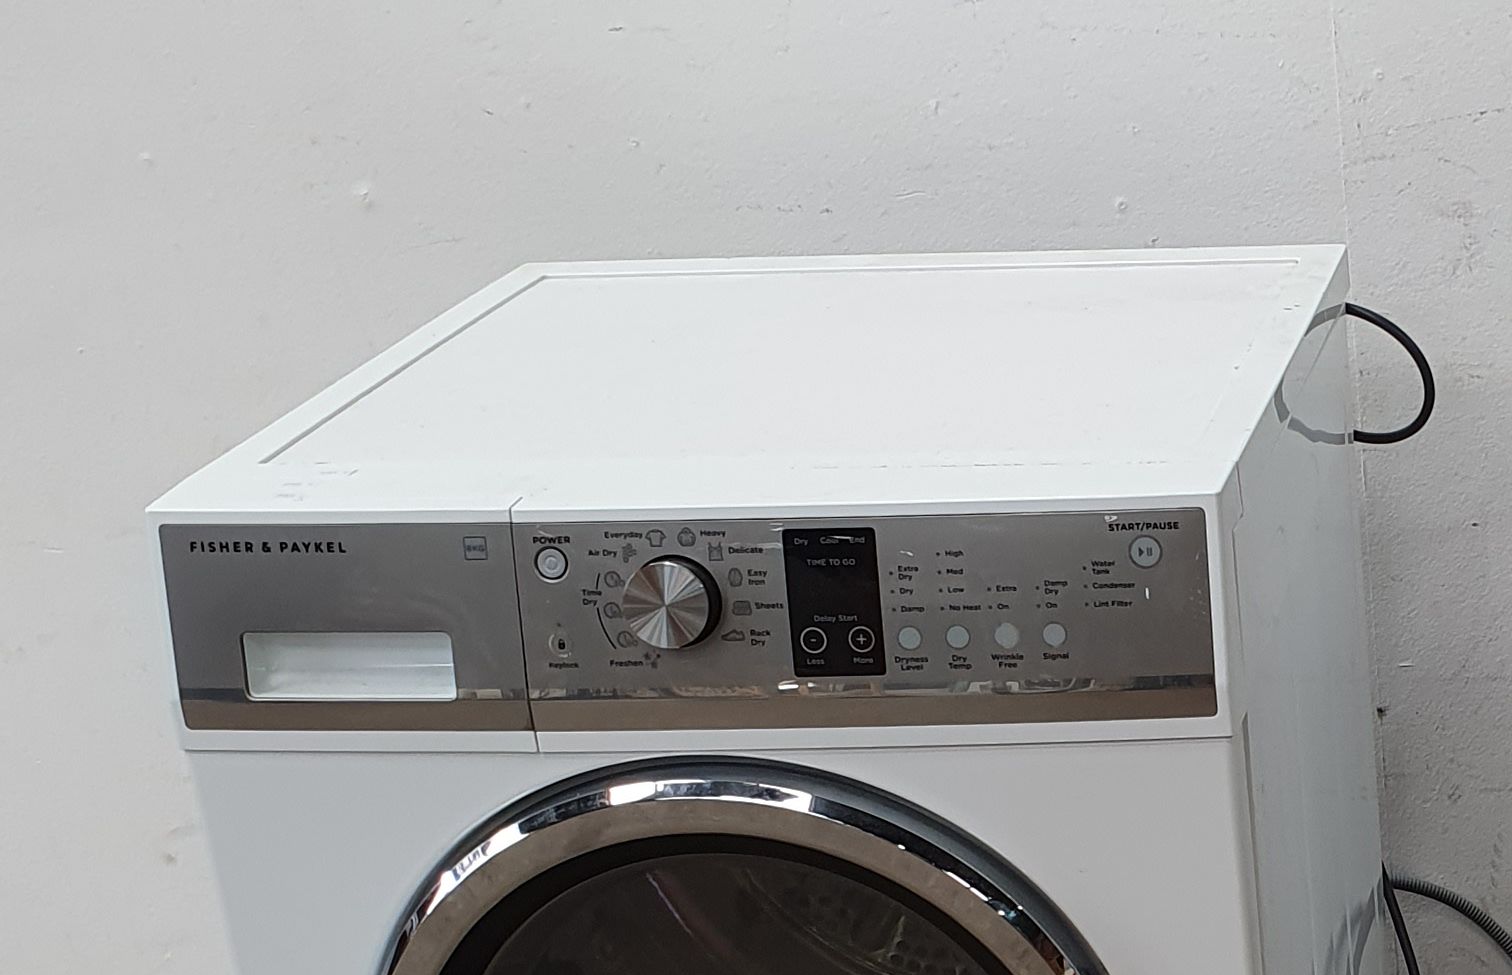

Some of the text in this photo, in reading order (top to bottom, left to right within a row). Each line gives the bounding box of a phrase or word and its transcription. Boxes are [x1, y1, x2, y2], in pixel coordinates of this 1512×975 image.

[1108, 521, 1180, 532] START/PAUSE
[603, 531, 643, 540] Everyday
[700, 529, 727, 538] Heavy
[532, 535, 571, 545] POWER
[793, 537, 809, 546] Dry
[189, 541, 348, 554] FISHER & PAYKEL
[727, 546, 764, 555] Delicate
[588, 549, 618, 559] Air Dry
[944, 550, 964, 558] High
[806, 558, 856, 566] TIME TO GO
[1091, 560, 1116, 568] Water
[747, 569, 768, 578] Easy
[897, 565, 919, 573] Extra
[946, 568, 964, 576] Med
[748, 578, 766, 586] Iron
[898, 573, 913, 582] Dry
[996, 584, 1017, 592] Extra
[1043, 580, 1068, 588] Damp
[1092, 581, 1136, 590] Condenser
[581, 589, 603, 597] Time
[899, 587, 914, 596] Dry
[947, 586, 965, 594] Low
[1044, 587, 1059, 595] Dry
[582, 598, 599, 607] Dry
[754, 601, 784, 610] Sheets
[1093, 599, 1133, 608] Lint Filter
[900, 606, 925, 614] Damp
[813, 614, 858, 623] Delay Start
[750, 629, 771, 638] Rack
[750, 638, 767, 648] Dry
[894, 655, 929, 664] Dryness
[951, 654, 968, 663] Dry
[991, 653, 1025, 661] Wrinkle
[1042, 652, 1070, 661] Signal
[548, 662, 579, 670] Keylock
[609, 659, 644, 667] Freshen
[948, 663, 972, 671] Temp
[998, 661, 1018, 669] Free
